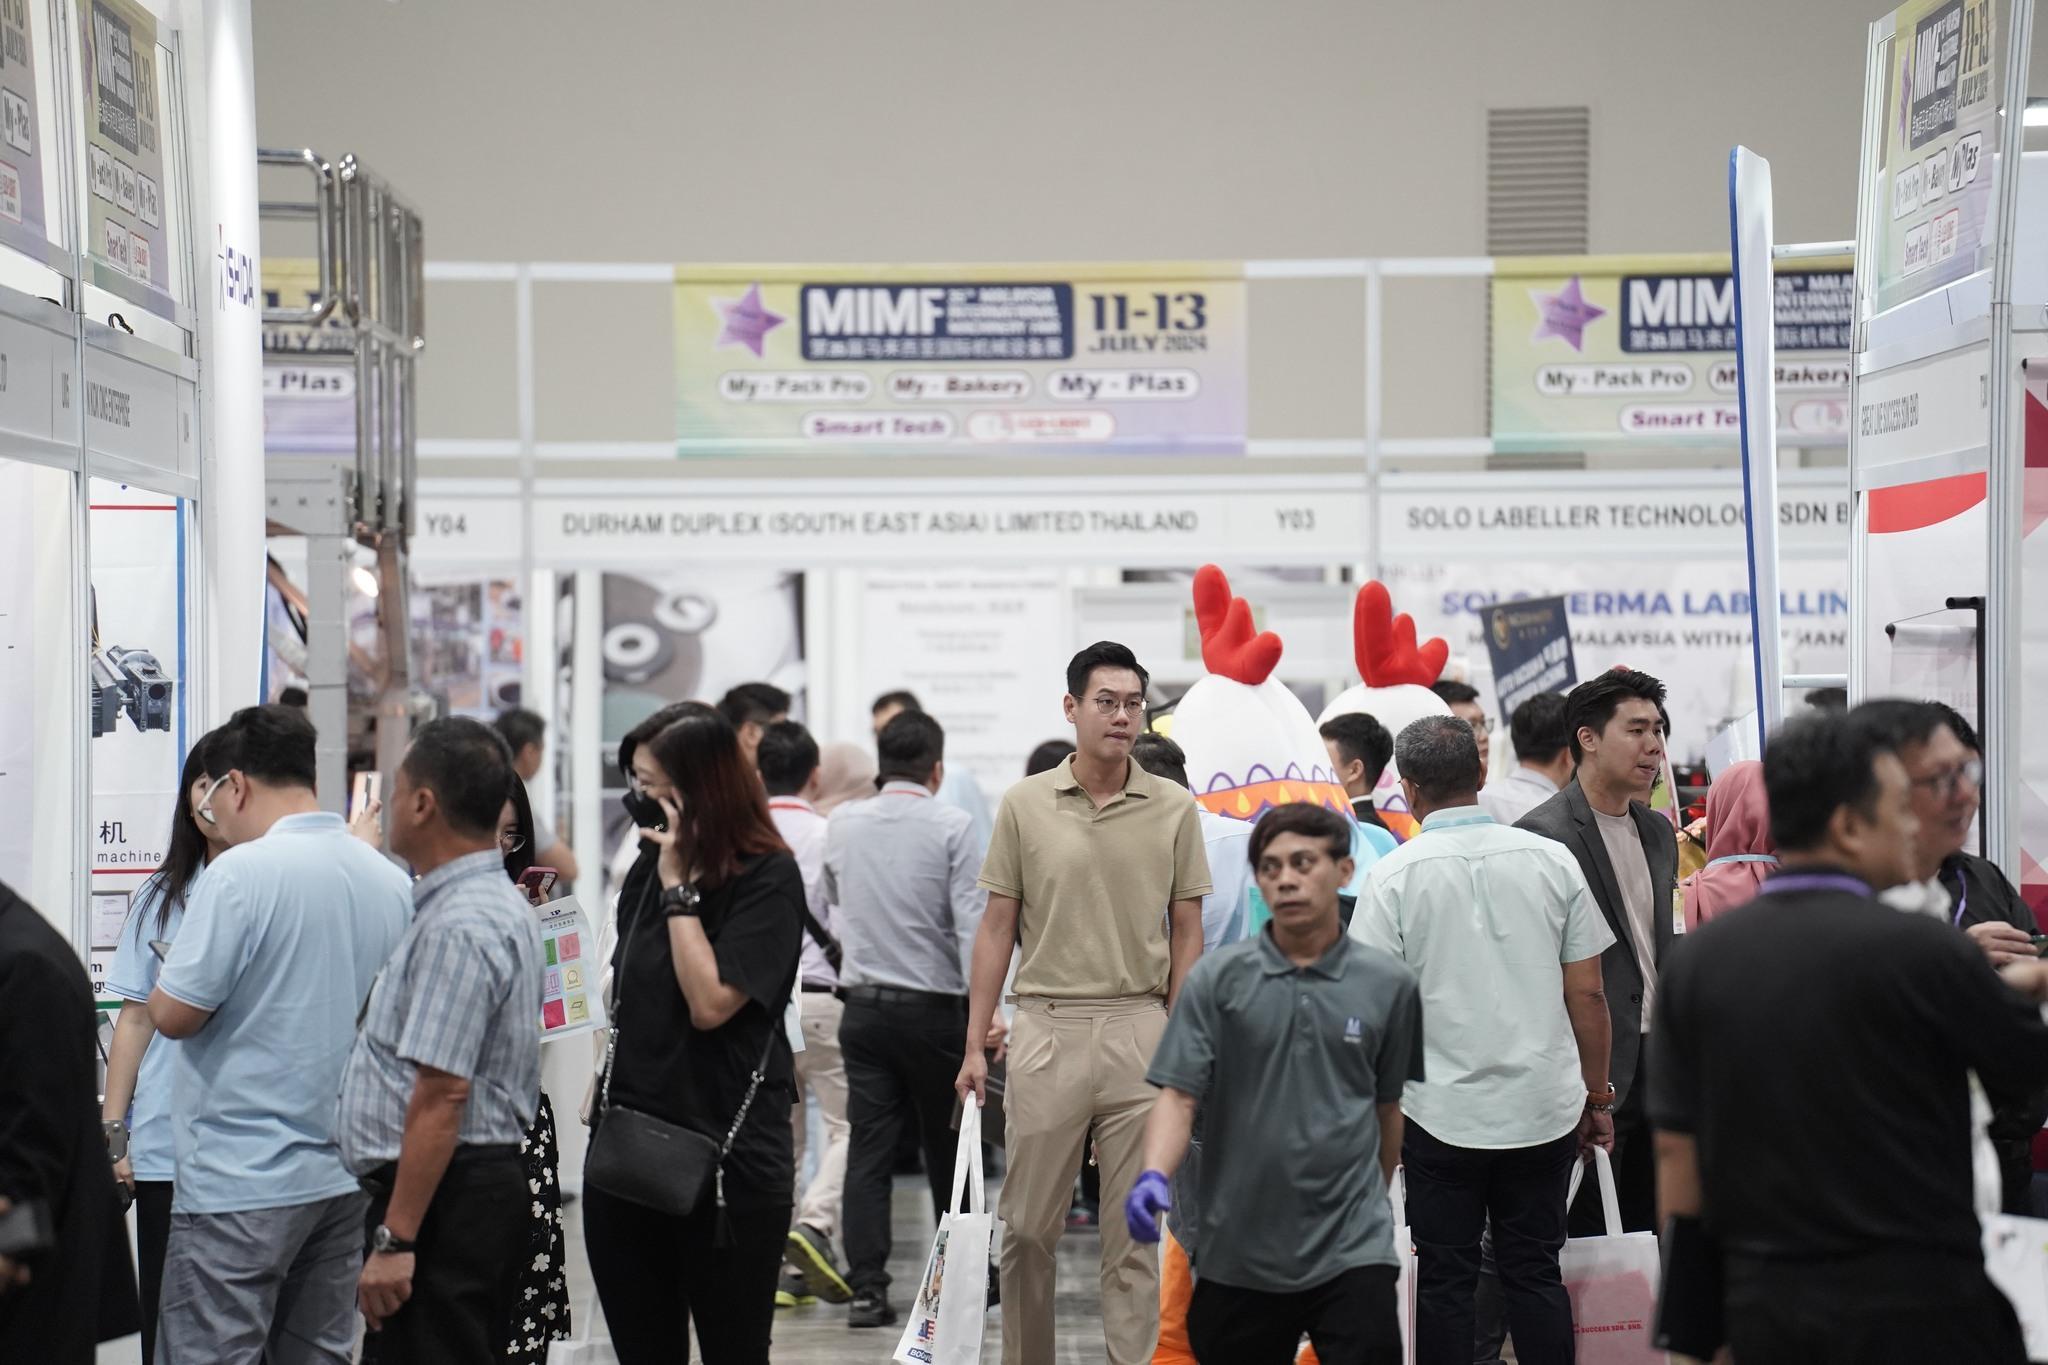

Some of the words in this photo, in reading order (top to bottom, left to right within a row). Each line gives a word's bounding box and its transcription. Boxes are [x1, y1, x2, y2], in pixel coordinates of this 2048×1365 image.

[808, 288, 946, 336] MIMF
[1089, 292, 1208, 332] 11-13
[1089, 335, 1158, 354] JULY
[281, 373, 341, 390] Plas
[1545, 372, 1574, 394] My
[1596, 370, 1643, 387] Pack
[1651, 369, 1687, 386] Pro
[814, 417, 885, 434] Smart
[1632, 410, 1702, 427] Smart
[425, 514, 467, 537] Y04
[563, 513, 664, 536] DURHAM
[670, 512, 762, 535] DUPLEX
[769, 512, 855, 535] (SOUTH
[862, 512, 920, 534] EAST
[928, 511, 987, 534] ASIA)
[996, 511, 1084, 533] LIMITED
[1089, 510, 1199, 532] THAILAND
[1276, 508, 1315, 531] Y03
[1407, 506, 1471, 530] SOLO
[1478, 505, 1600, 530] LABELLER
[1779, 501, 1828, 526] SDN
[98, 820, 127, 846] 机
[97, 849, 162, 864] machine
